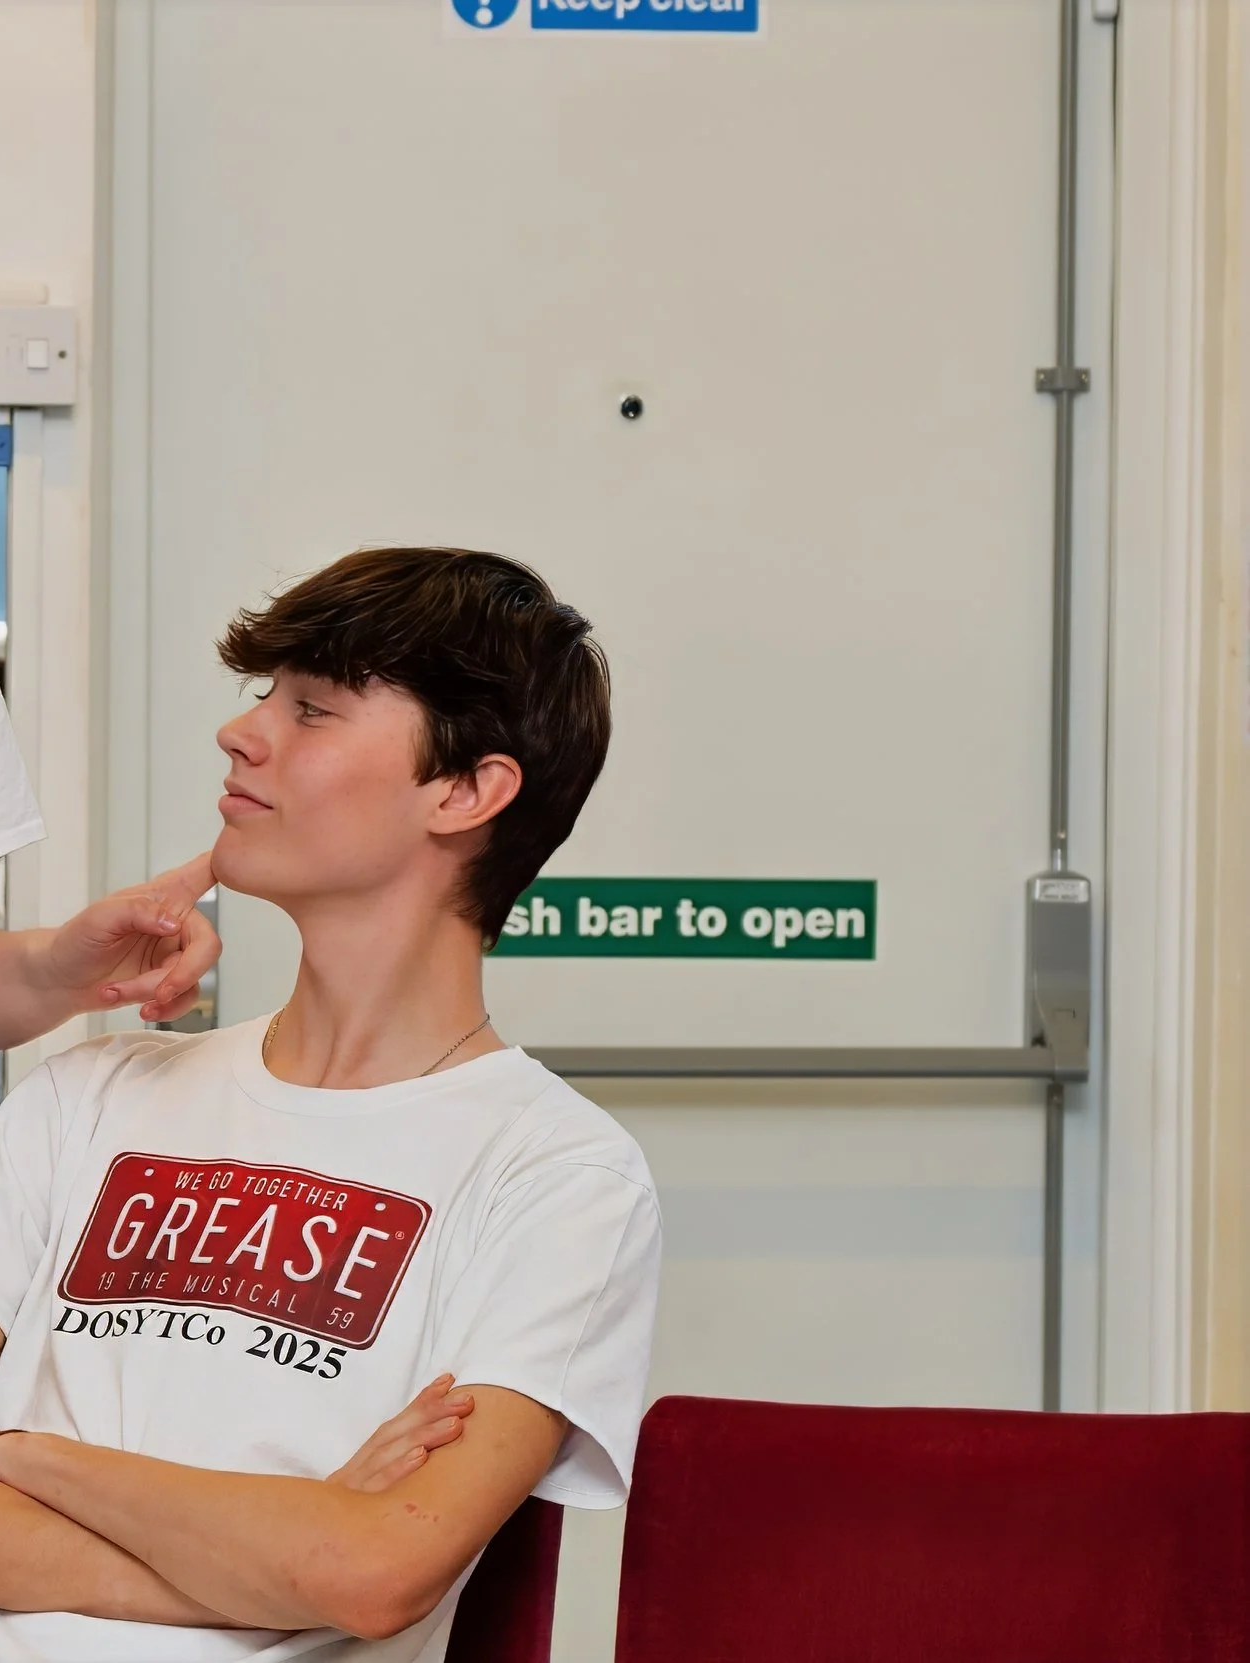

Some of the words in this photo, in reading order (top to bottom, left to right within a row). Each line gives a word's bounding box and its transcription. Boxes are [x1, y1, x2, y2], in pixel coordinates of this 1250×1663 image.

[501, 896, 561, 936] sh
[577, 897, 663, 938] bar
[676, 898, 728, 938] to
[741, 906, 866, 948] open
[174, 1170, 201, 1191] WE
[208, 1171, 234, 1190] GO
[242, 1176, 348, 1211] TOGETHER
[106, 1193, 390, 1300] GREASE
[97, 1272, 114, 1291] 19
[128, 1272, 169, 1290] THE
[182, 1274, 298, 1314] MUSICAL
[325, 1307, 355, 1330] 59
[53, 1306, 226, 1345] DOSYTCo
[245, 1325, 348, 1379] 2025
